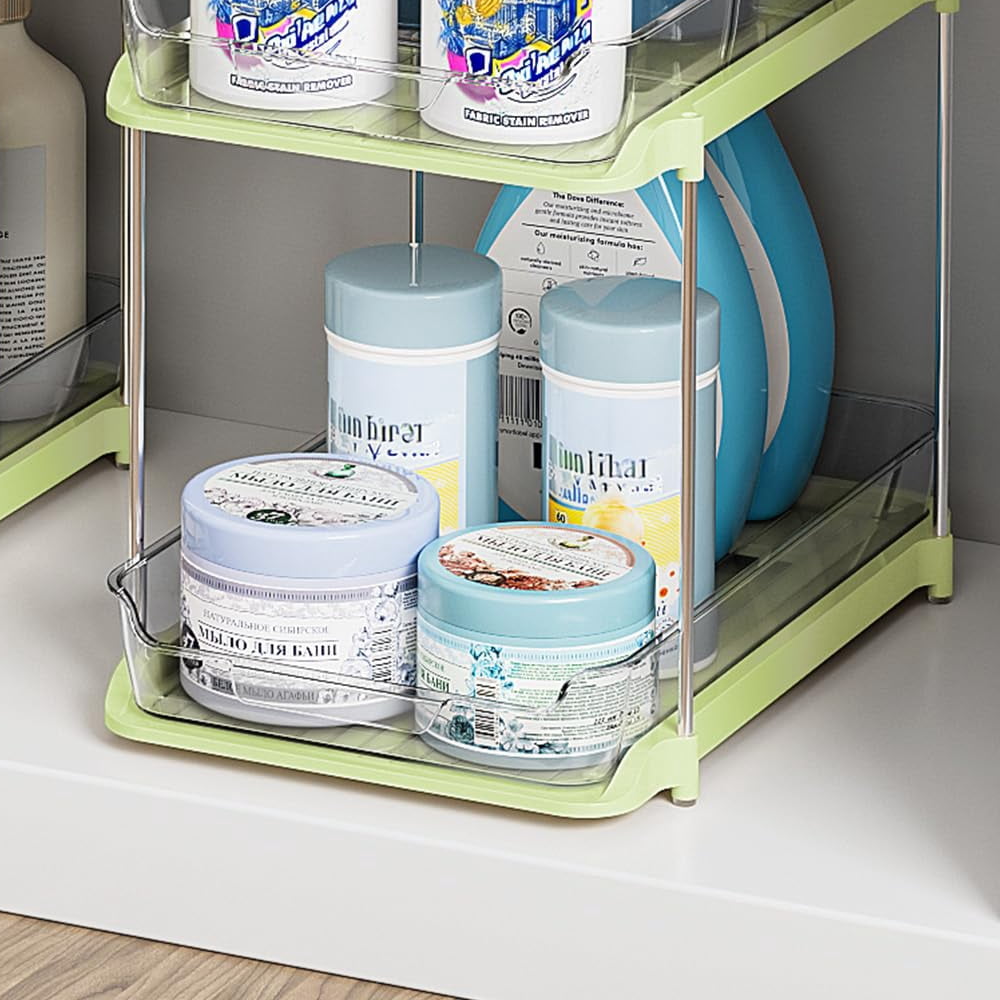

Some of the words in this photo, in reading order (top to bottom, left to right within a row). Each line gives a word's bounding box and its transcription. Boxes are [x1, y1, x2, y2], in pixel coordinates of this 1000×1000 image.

[302, 75, 352, 92] REMOVER
[464, 108, 500, 125] FABRIC
[502, 115, 537, 127] STAIN
[538, 109, 589, 127] REMOVER
[552, 191, 566, 200] The
[534, 230, 548, 239] Our
[550, 232, 595, 245] moisturizing
[597, 237, 626, 248] formula
[627, 240, 643, 251] has:
[199, 624, 248, 651] МЫЛО
[252, 641, 289, 657] ДЛЯ
